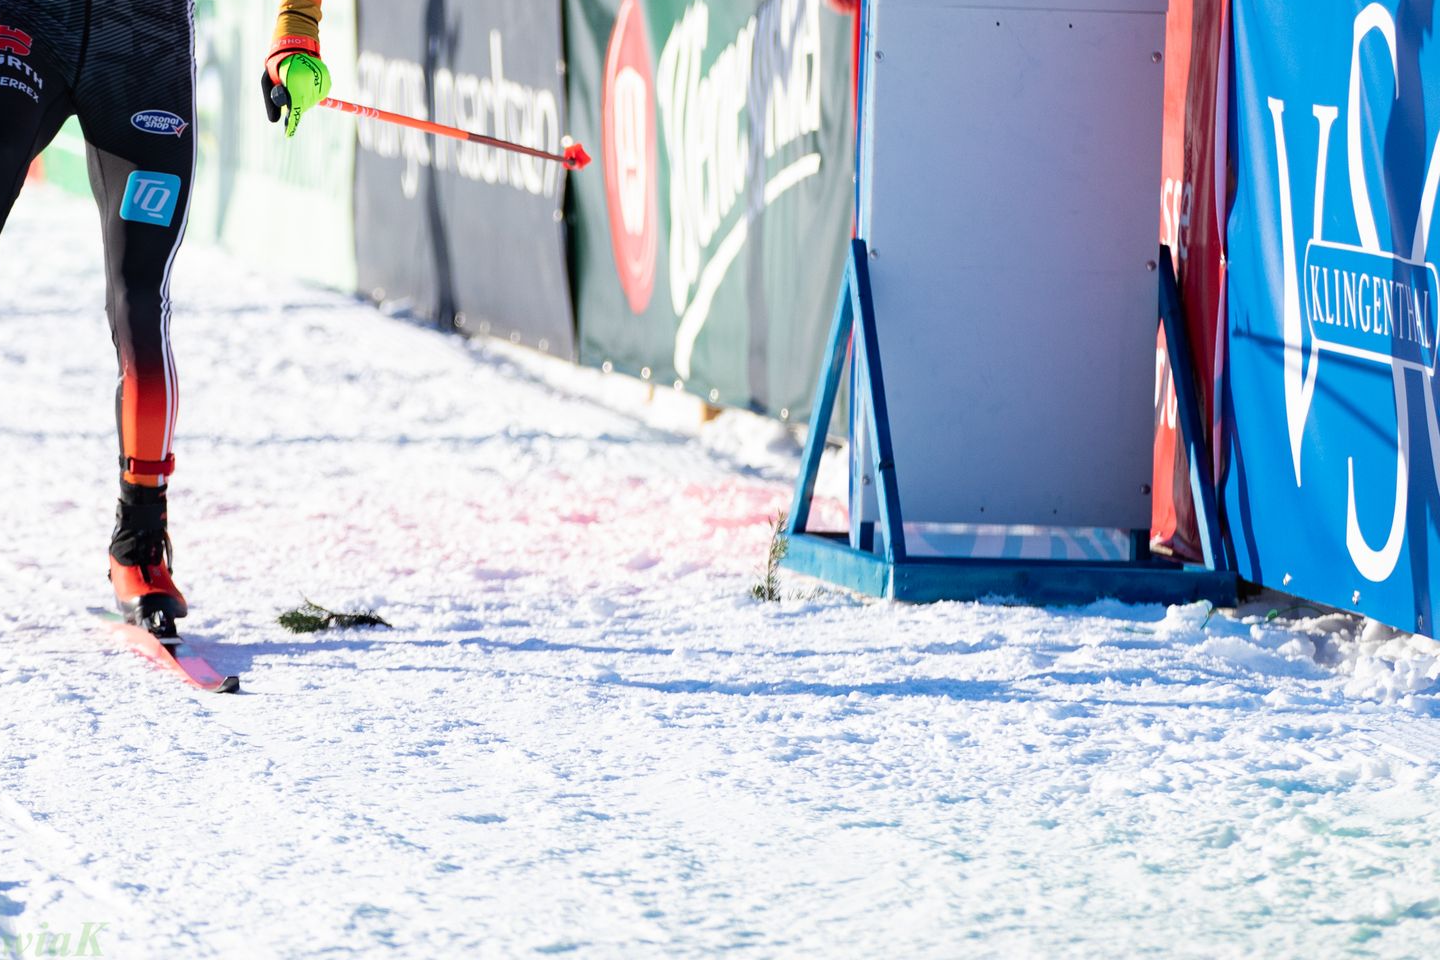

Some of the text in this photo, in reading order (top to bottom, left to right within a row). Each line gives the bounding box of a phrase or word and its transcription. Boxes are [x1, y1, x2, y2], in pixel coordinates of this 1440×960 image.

[135, 114, 180, 126] personal
[144, 121, 170, 131] shop
[133, 178, 171, 219] TQ
[1309, 264, 1432, 348] KLINGENTHAL
